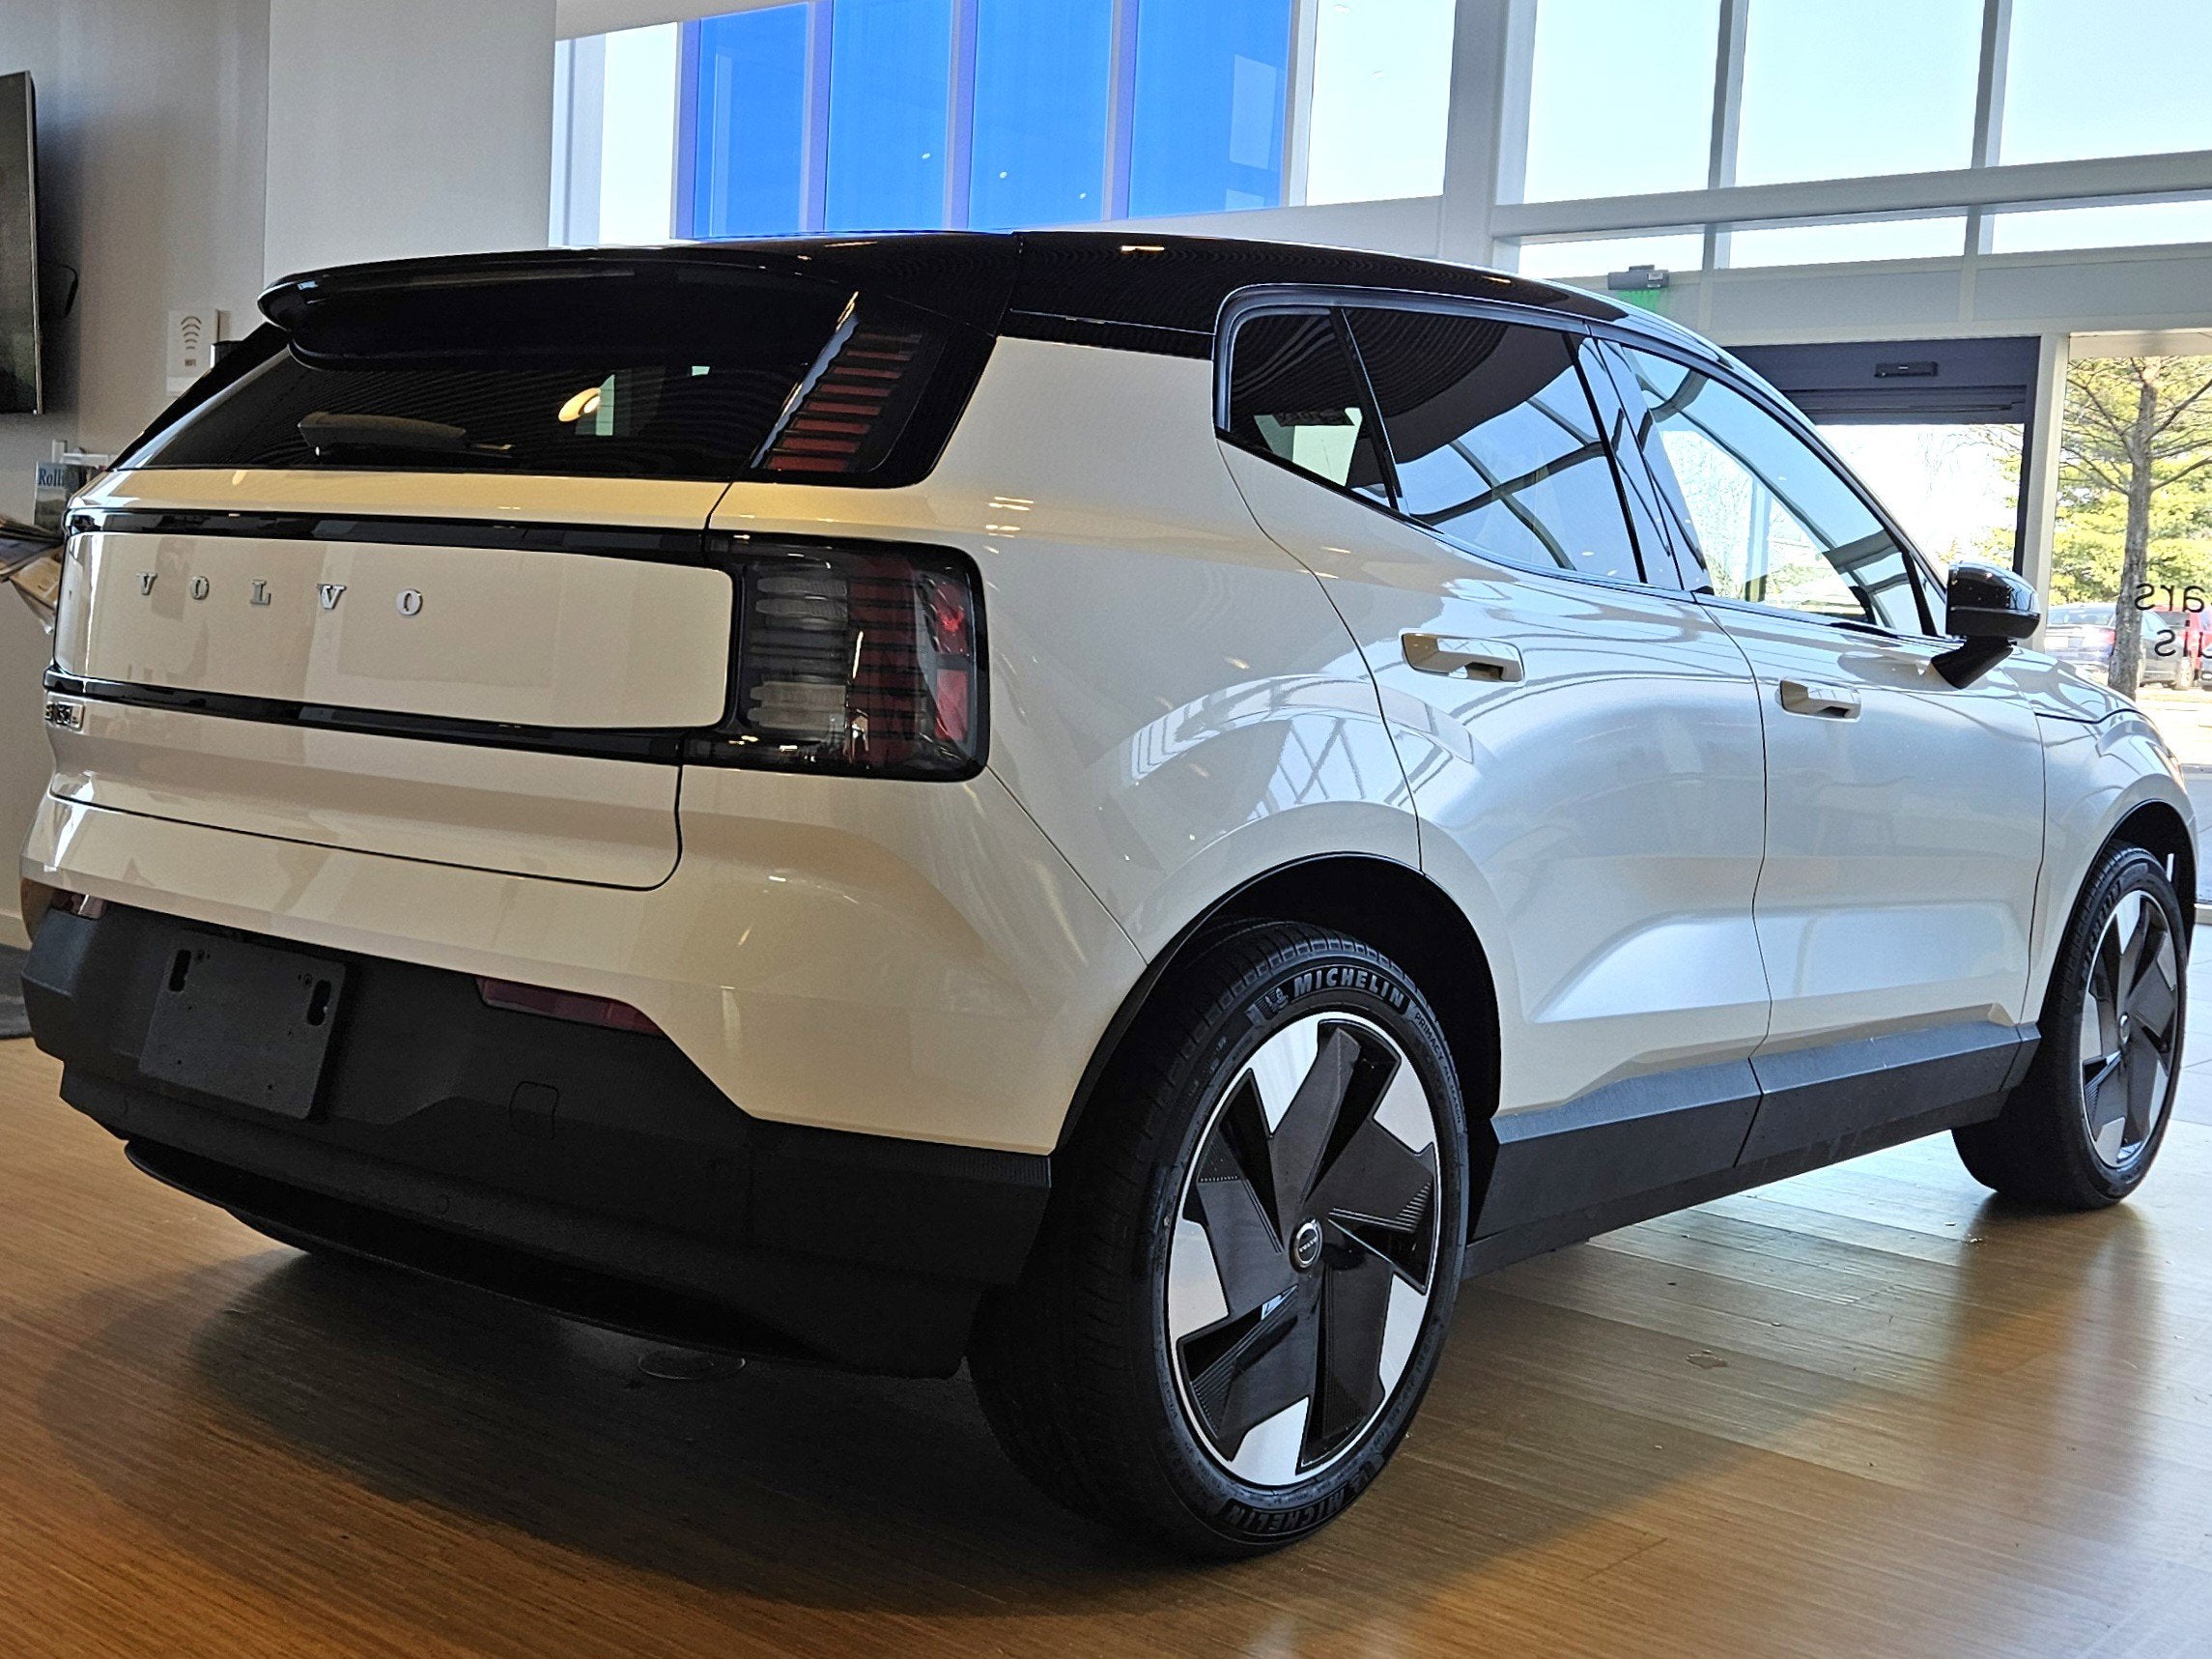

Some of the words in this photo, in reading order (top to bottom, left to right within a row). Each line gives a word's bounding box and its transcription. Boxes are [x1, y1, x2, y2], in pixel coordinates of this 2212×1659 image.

[135, 571, 424, 616] VOLVO
[1293, 967, 1404, 1009] MICHELIN
[1414, 1012, 1444, 1061] PRIMACY
[1223, 1488, 1347, 1532] MICHELIN
